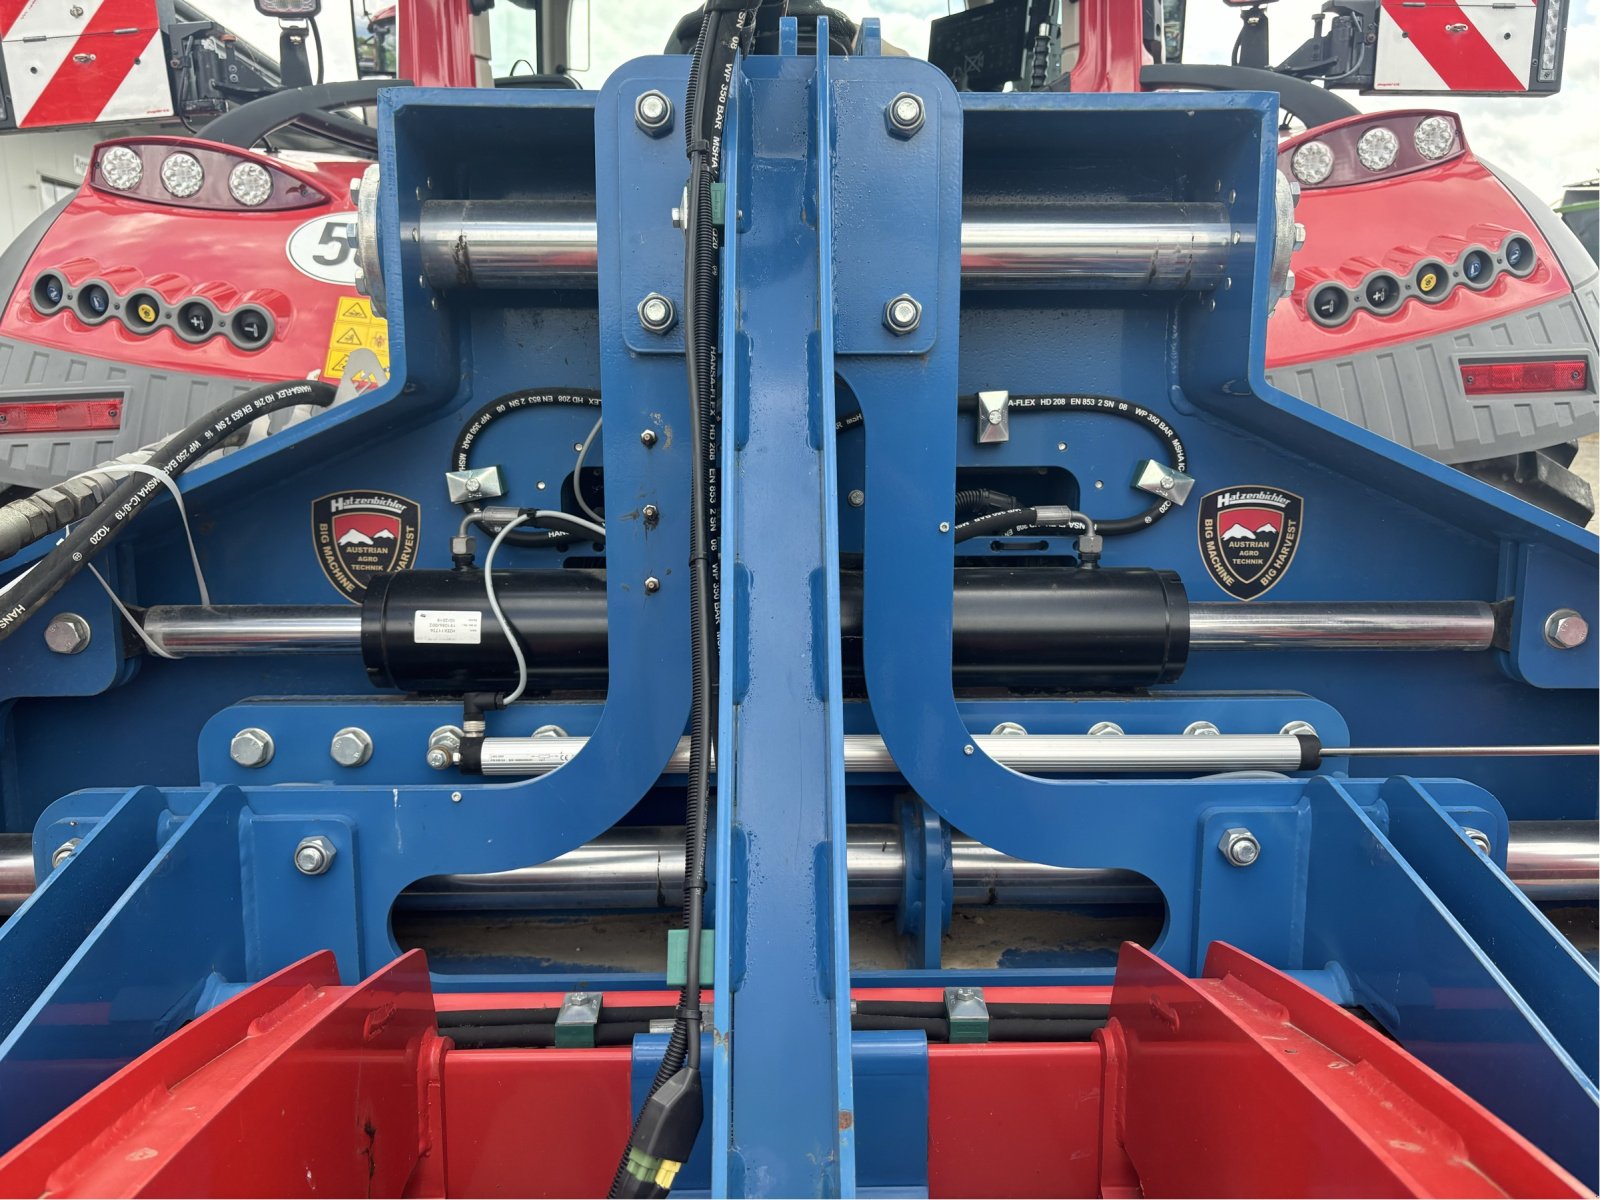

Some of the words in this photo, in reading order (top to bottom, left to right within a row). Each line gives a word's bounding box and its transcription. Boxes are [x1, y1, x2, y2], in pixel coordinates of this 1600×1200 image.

[730, 36, 740, 50] 08
[723, 63, 733, 83] WP
[718, 84, 729, 103] 350
[713, 106, 725, 130] BAR
[711, 136, 721, 168] MSHA
[265, 394, 275, 404] HD
[276, 385, 312, 399] HANSA-FLEX
[254, 398, 265, 408] 216
[508, 400, 520, 408] SN
[528, 396, 541, 404] 853
[572, 396, 583, 404] HD
[232, 409, 243, 421] 853
[243, 404, 253, 415] EN
[496, 404, 506, 413] 08
[215, 420, 227, 432] SN
[224, 417, 232, 425] 2
[481, 413, 492, 425] WP
[204, 429, 214, 440] 16
[469, 422, 482, 435] 350
[709, 424, 716, 440] HD
[1040, 398, 1052, 406] HD
[1052, 398, 1066, 406] 208
[1070, 398, 1082, 406] EN
[1082, 398, 1095, 406] 853
[1097, 399, 1103, 407] 2
[1103, 399, 1115, 408] SN
[1118, 402, 1128, 411] 08
[1134, 407, 1148, 419] WP
[1146, 413, 1160, 426] 350
[1158, 421, 1173, 438] BAR
[1171, 438, 1185, 463] MSHA
[189, 440, 202, 454] WP
[461, 433, 475, 450] BAR
[176, 448, 190, 463] 250
[709, 468, 716, 484] EN
[137, 477, 160, 497] MSHA
[331, 496, 407, 513] Hatzenbichler
[1217, 491, 1292, 508] Hatzenbichler
[114, 494, 140, 521] IC-8/19
[709, 517, 717, 532] SN
[1204, 518, 1213, 539] BIG
[89, 526, 110, 545] 1Q20
[319, 523, 330, 544] BIG
[346, 546, 388, 554] AUSTRIAN
[394, 525, 415, 572] HARVEST
[710, 538, 718, 551] 08
[1259, 569, 1277, 586] BIG
[1274, 519, 1297, 568] HARVEST
[323, 546, 355, 593] MACHINE
[1206, 540, 1235, 587] MACHINE
